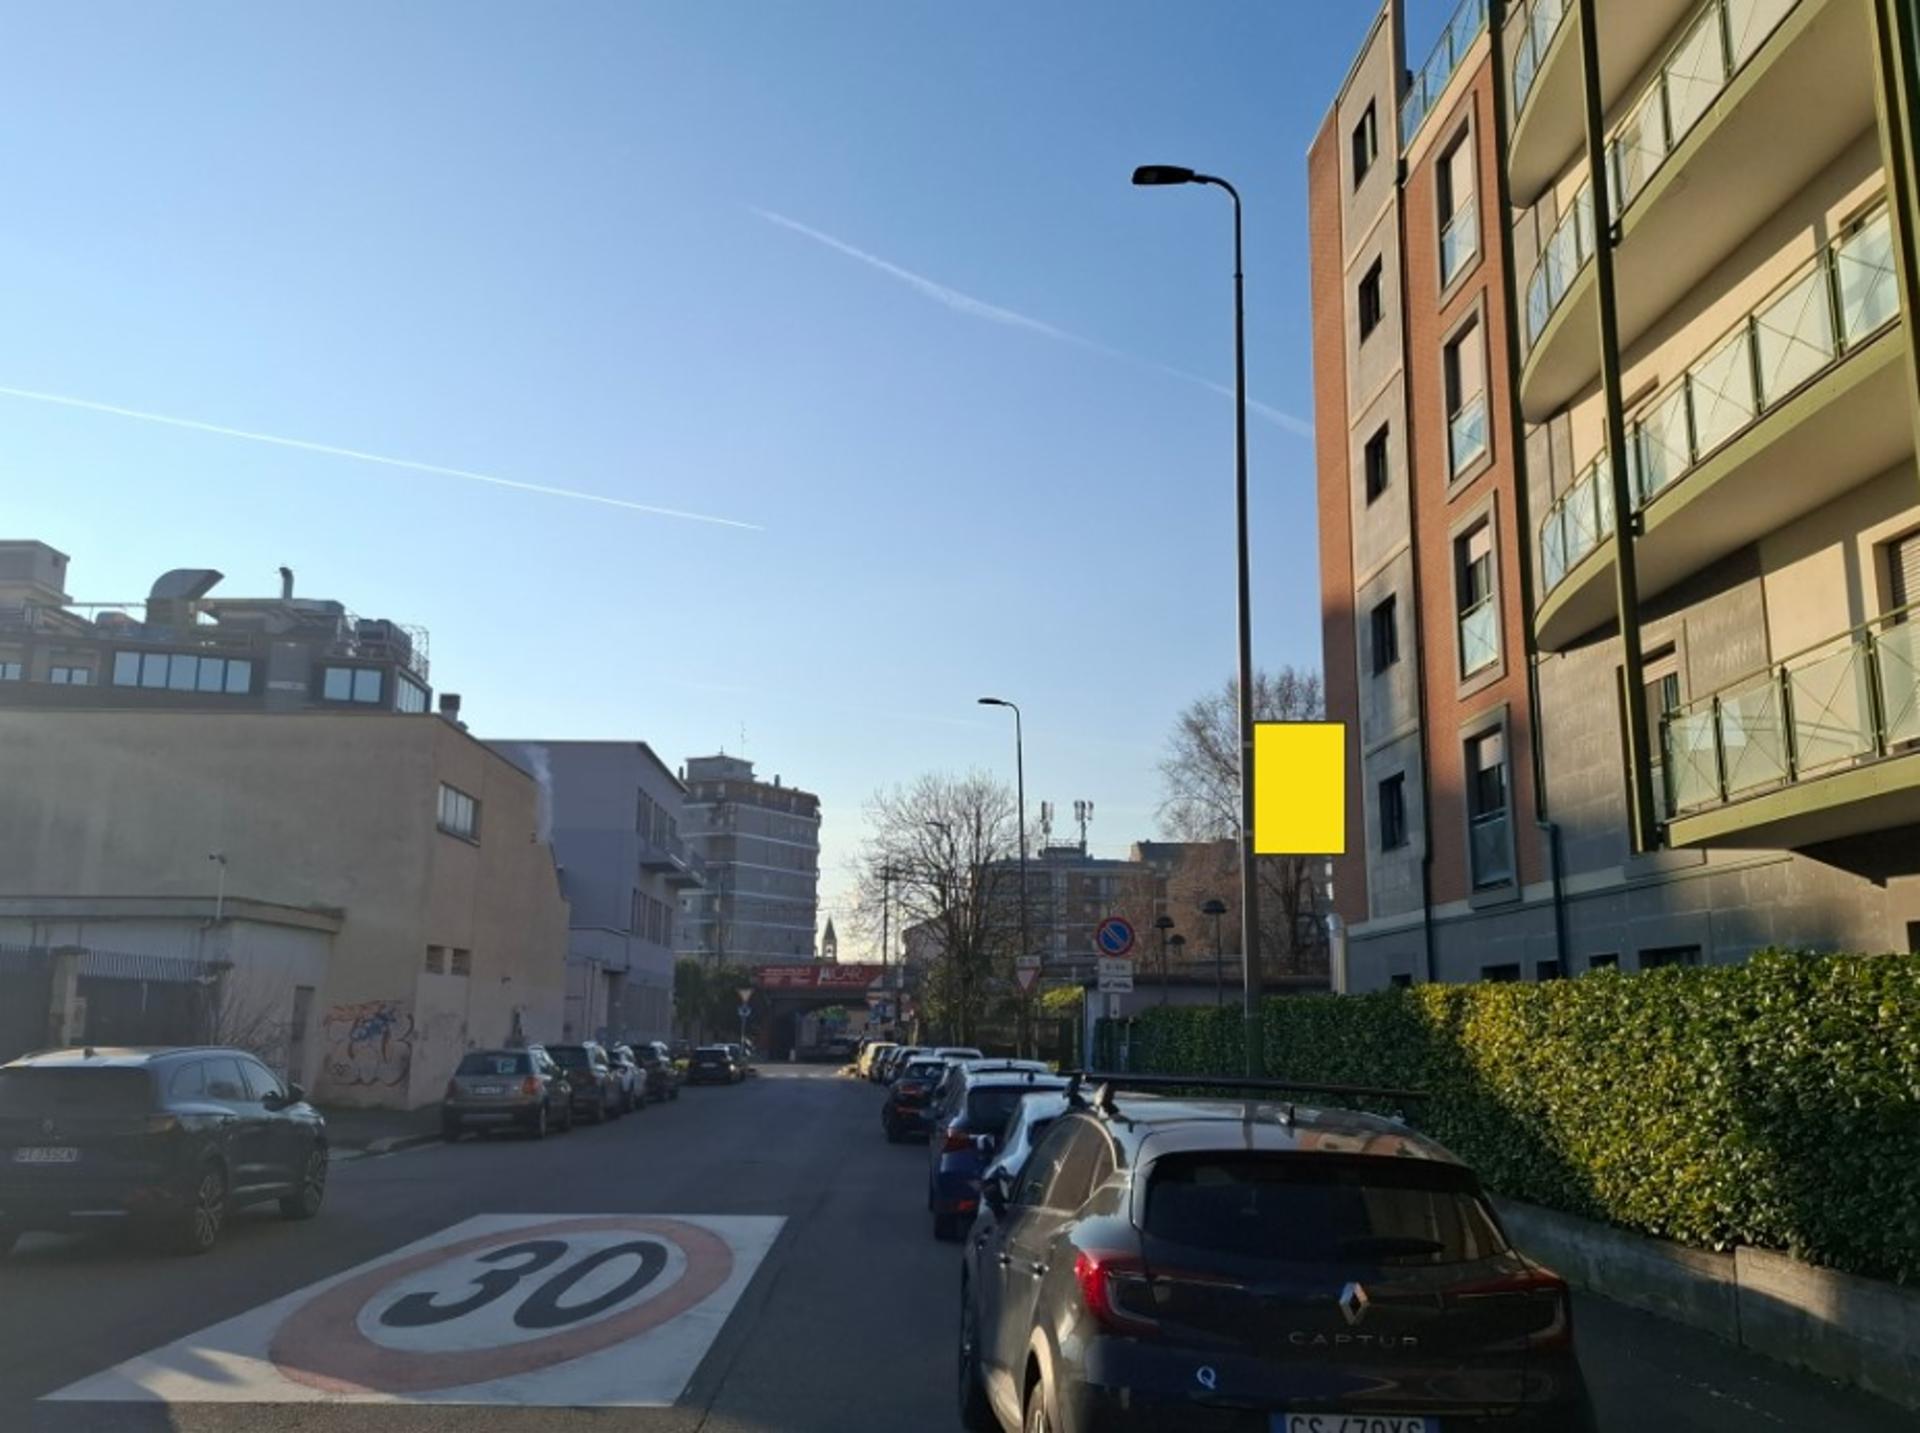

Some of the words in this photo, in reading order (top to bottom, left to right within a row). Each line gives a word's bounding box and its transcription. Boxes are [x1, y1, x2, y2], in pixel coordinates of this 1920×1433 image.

[380, 1239, 667, 1329] 30
[1288, 1331, 1418, 1348] CAPTUR
[1196, 1365, 1217, 1389] Q
